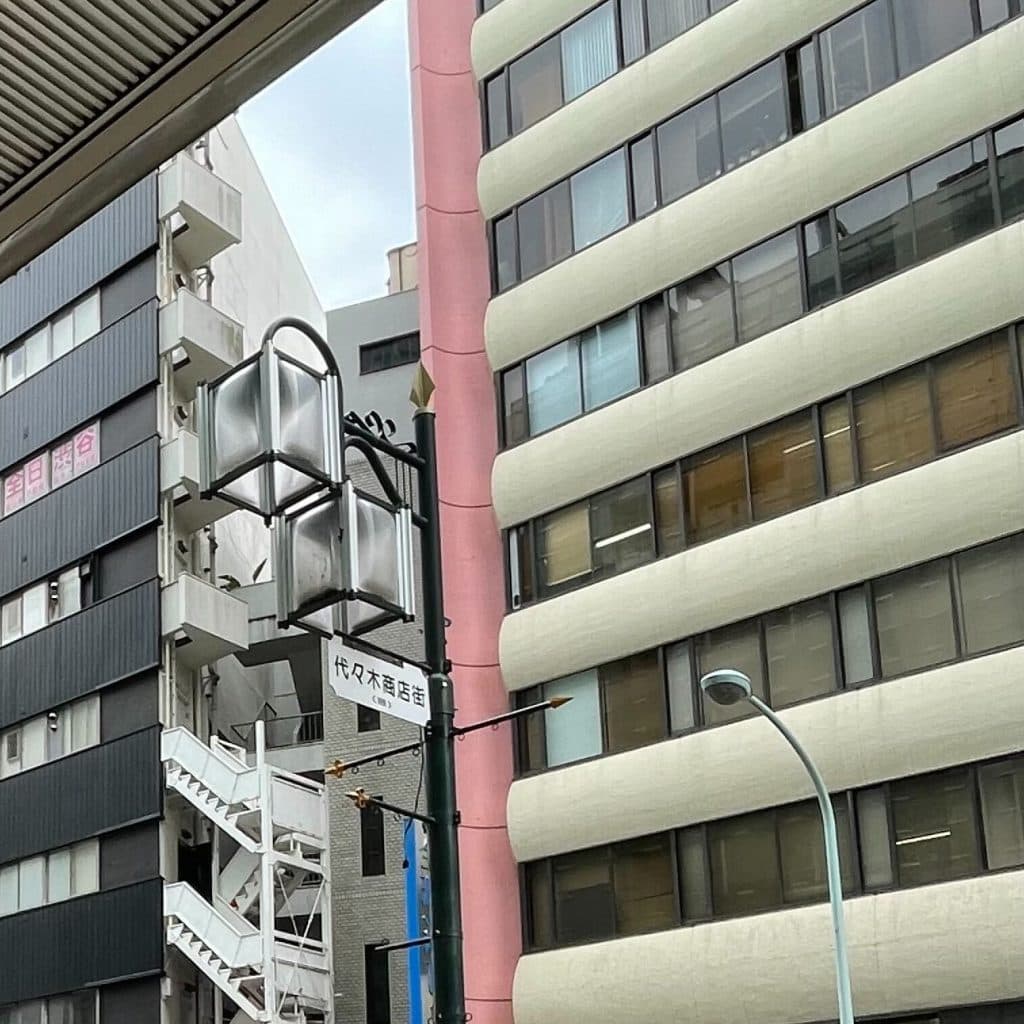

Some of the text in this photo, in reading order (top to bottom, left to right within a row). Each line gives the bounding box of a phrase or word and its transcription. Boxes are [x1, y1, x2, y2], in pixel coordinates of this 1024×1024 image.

[335, 655, 425, 708] 代々木商店街
